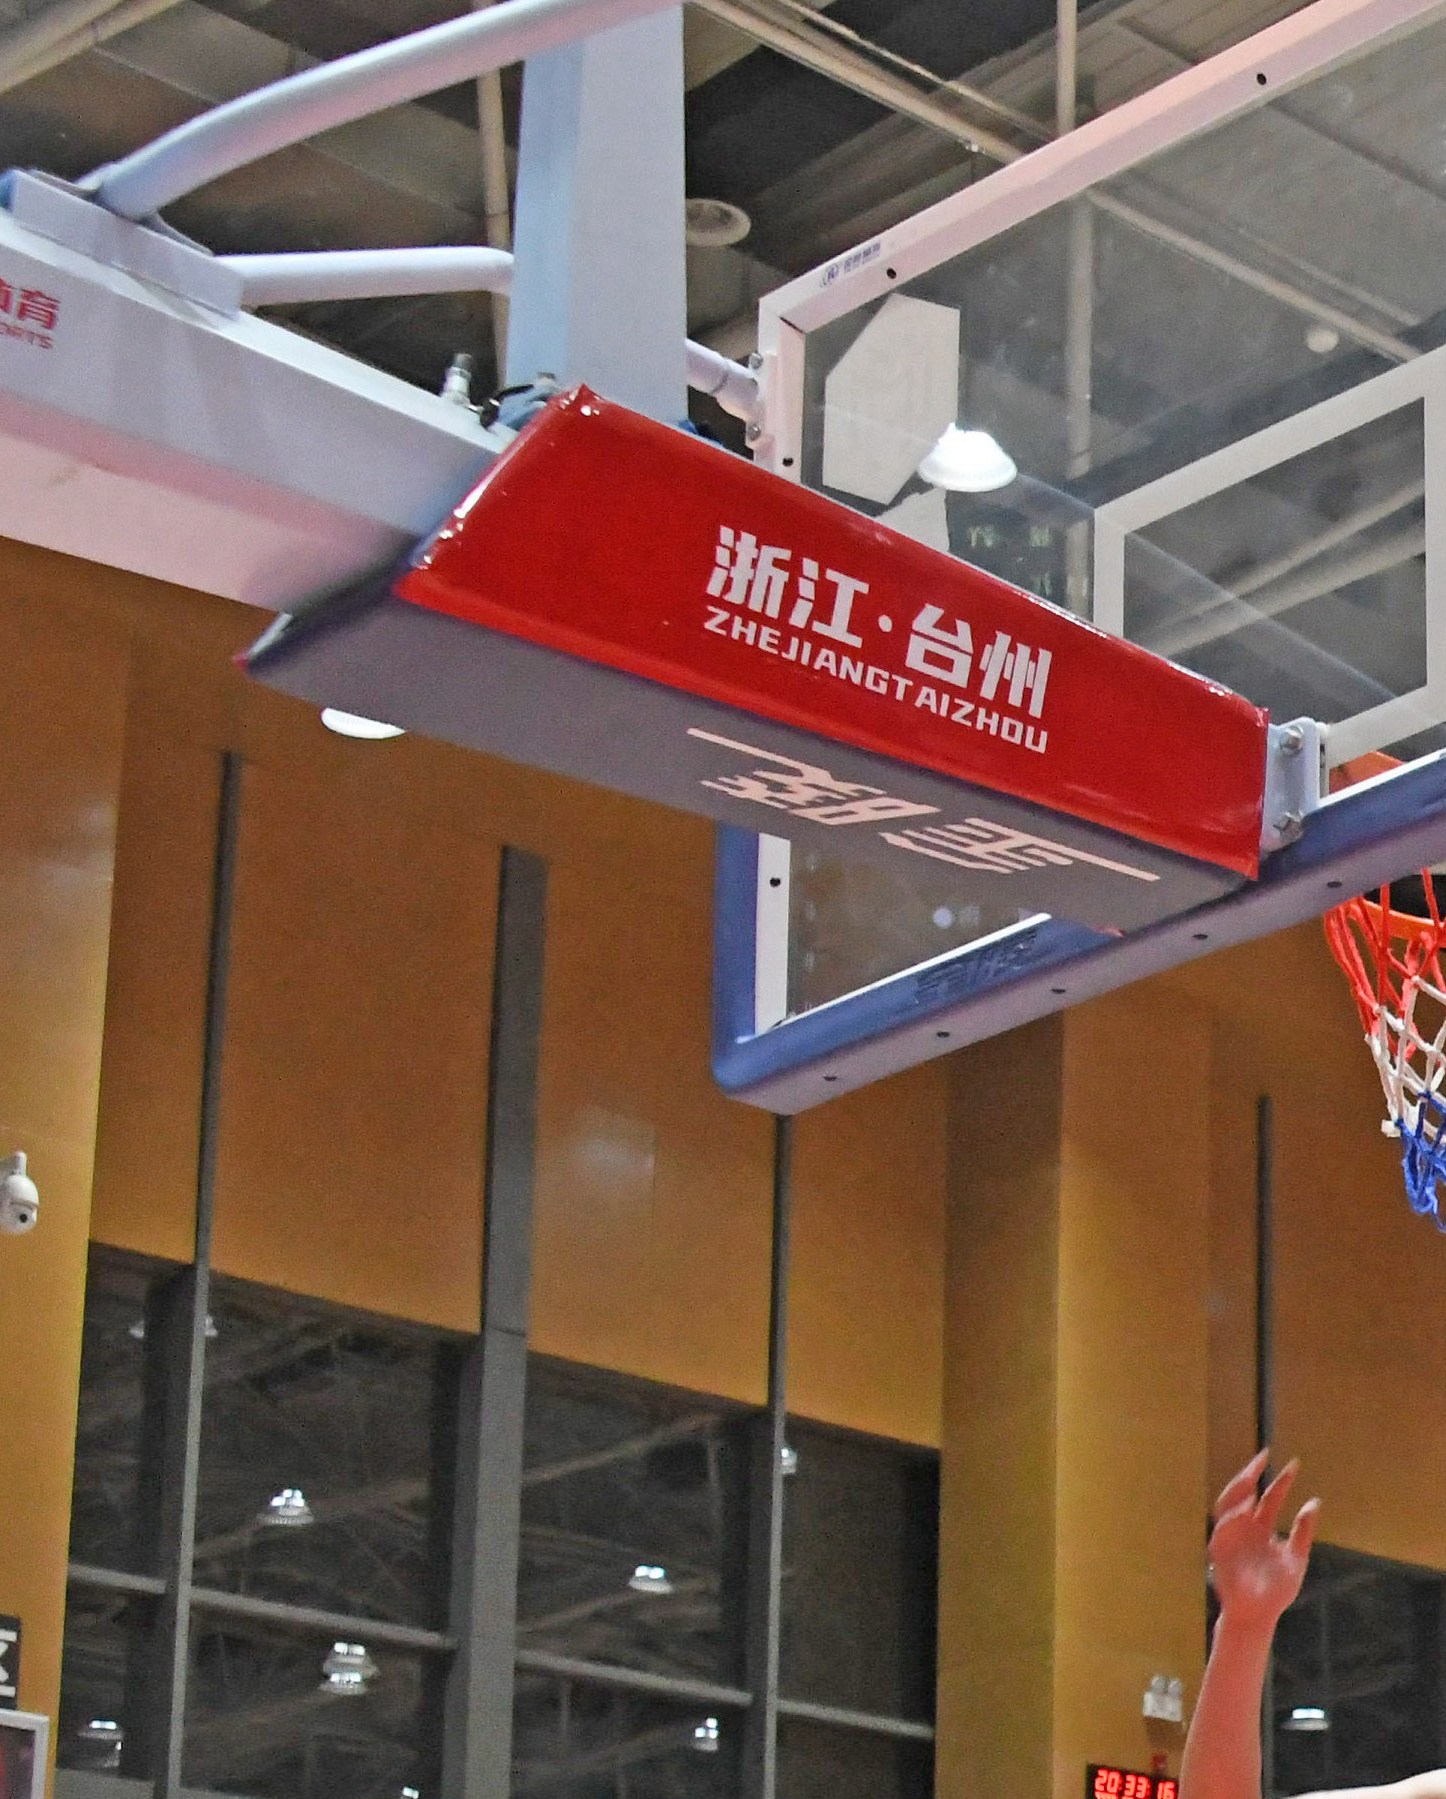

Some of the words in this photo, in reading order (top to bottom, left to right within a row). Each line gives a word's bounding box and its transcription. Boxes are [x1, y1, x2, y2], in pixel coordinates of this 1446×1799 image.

[703, 604, 1049, 754] ZHEJIANGTAIZHOU
[706, 525, 1054, 719] 浙江·台州
